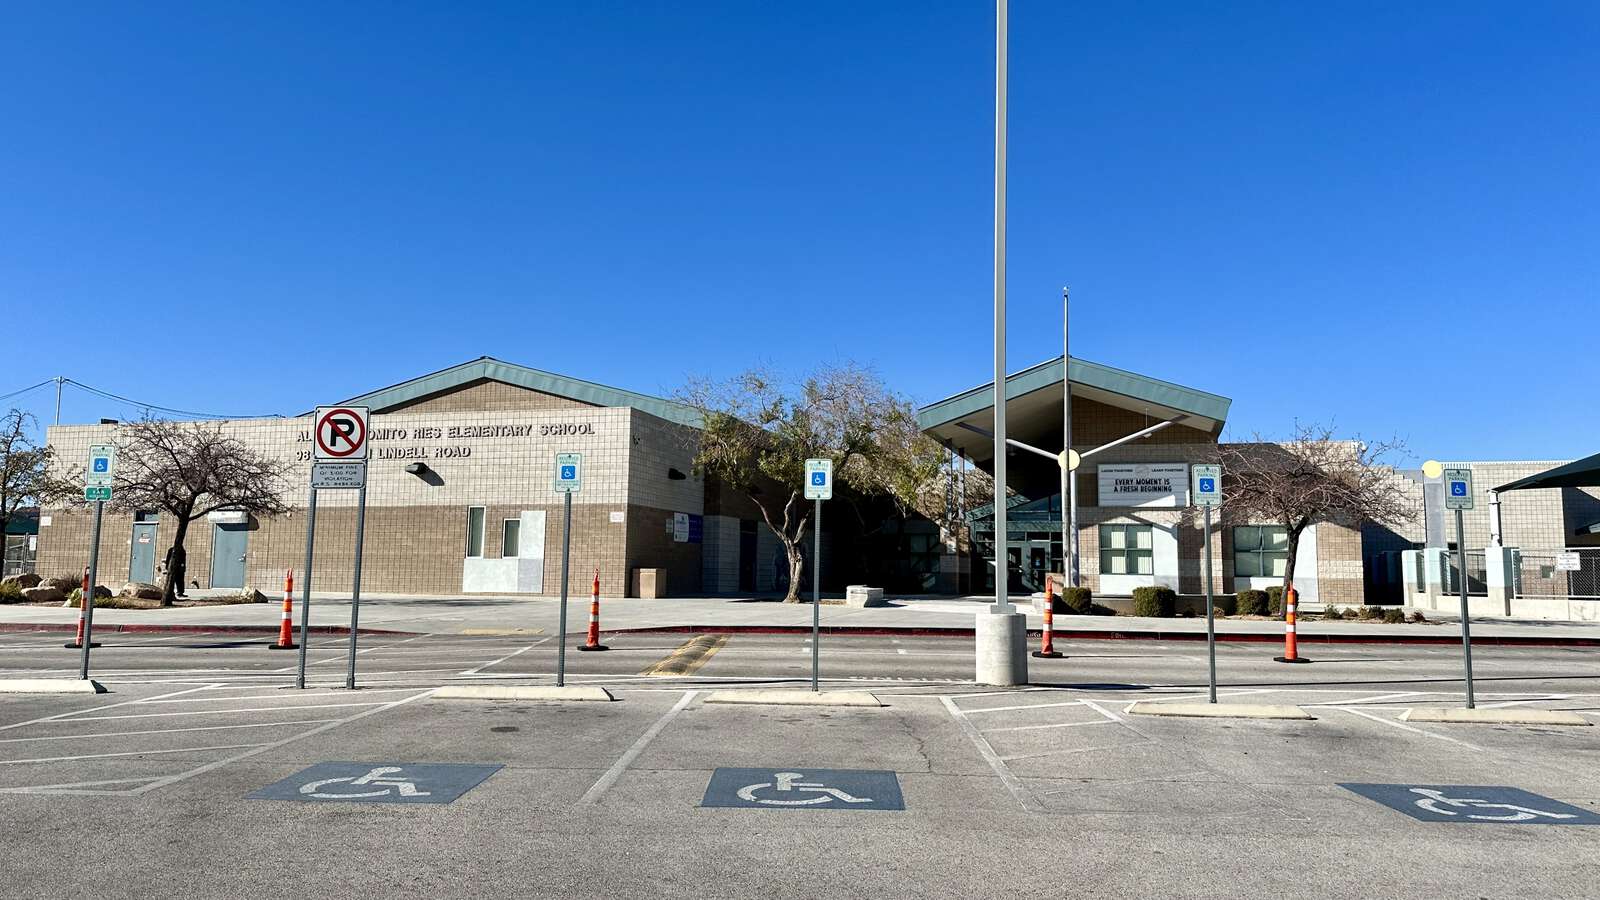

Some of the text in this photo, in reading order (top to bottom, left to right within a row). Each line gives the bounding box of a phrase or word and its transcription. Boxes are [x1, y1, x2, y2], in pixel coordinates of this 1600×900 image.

[368, 428, 407, 441] OMITO
[413, 427, 442, 440] RIES
[447, 424, 533, 439] ELEMENTARY
[539, 422, 596, 437] SCHOOL
[378, 447, 428, 460] LINDELL
[434, 446, 471, 459] ROAD
